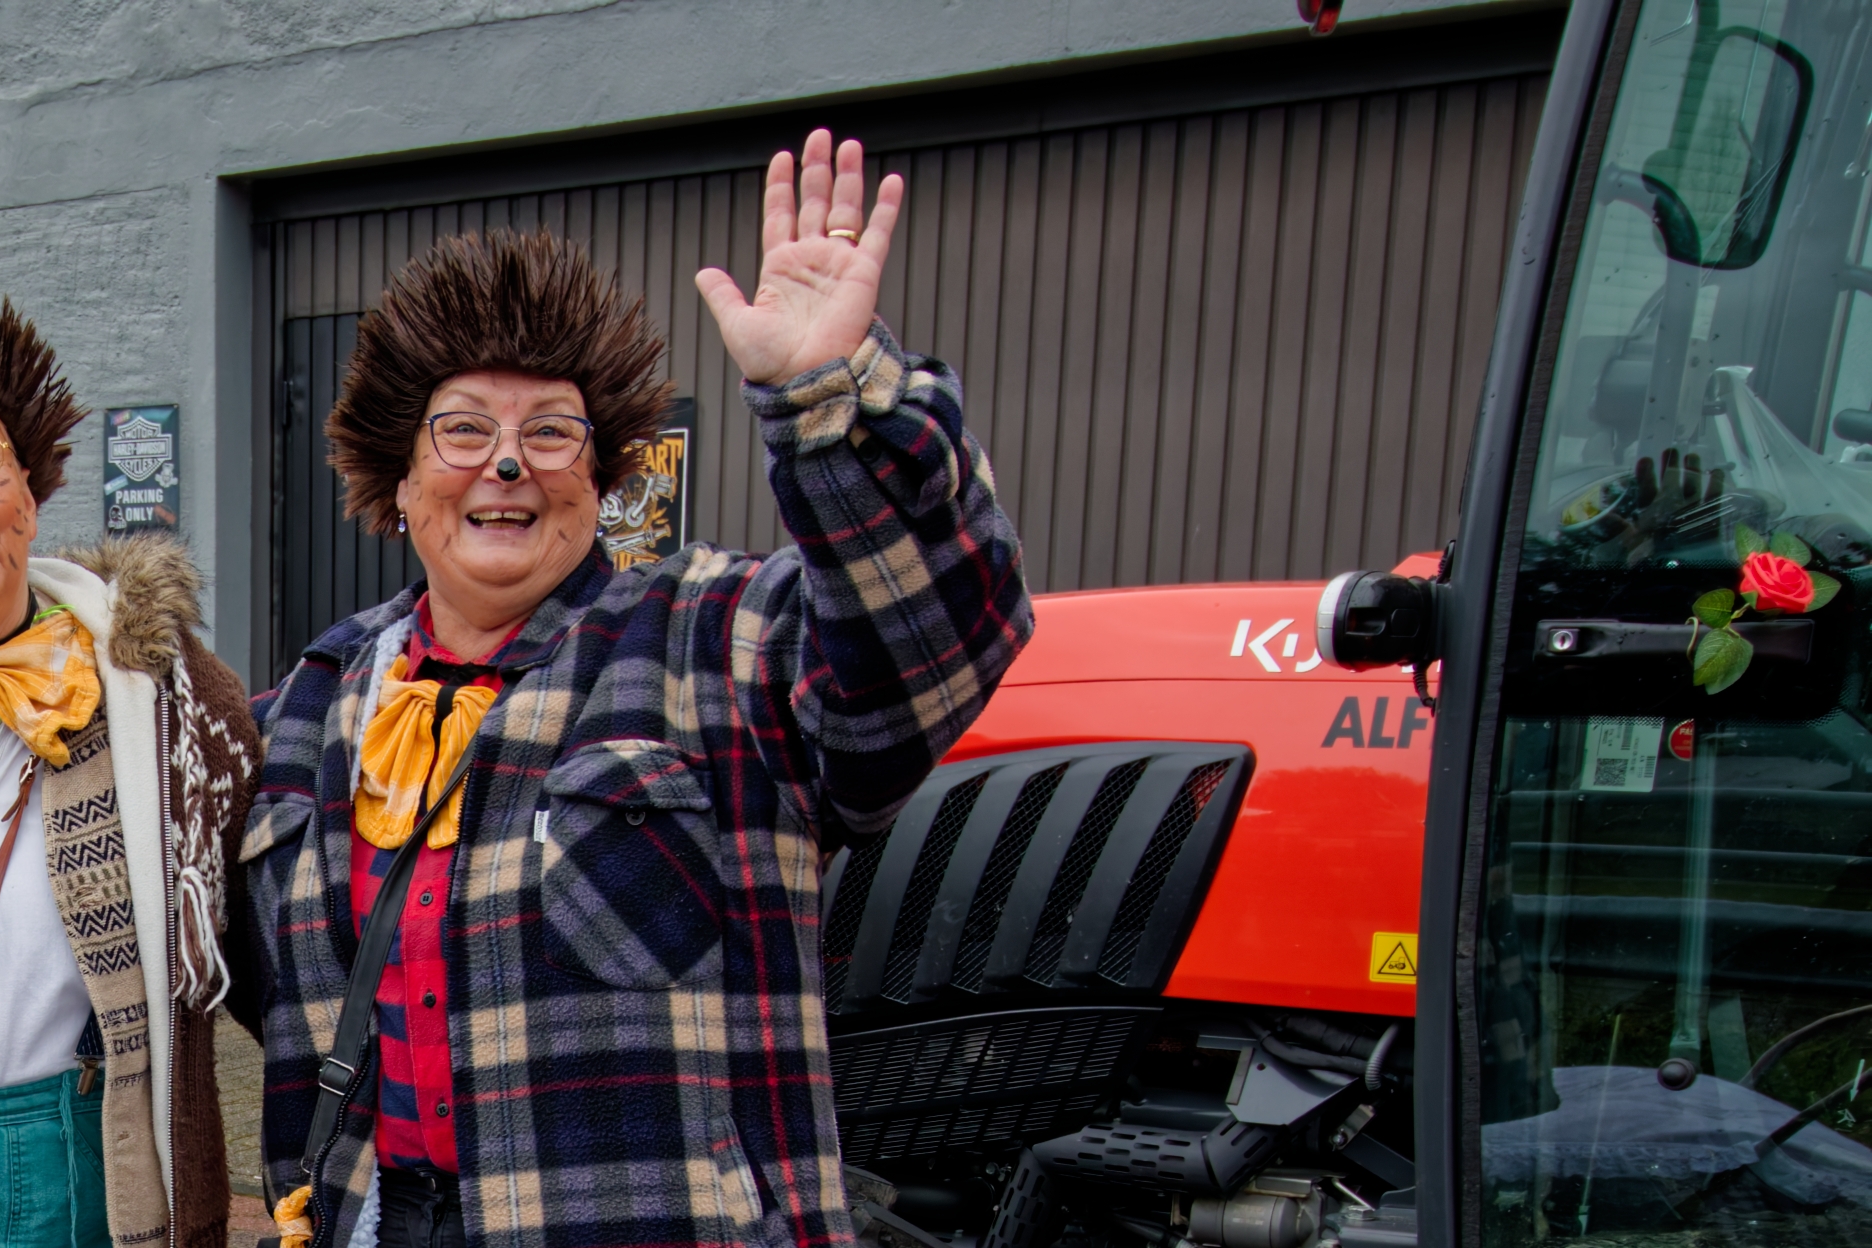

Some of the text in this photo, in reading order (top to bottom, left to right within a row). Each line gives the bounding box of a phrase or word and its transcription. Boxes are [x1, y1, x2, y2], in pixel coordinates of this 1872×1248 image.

[124, 425, 155, 439] MOTOR
[115, 489, 164, 504] PARKING
[125, 507, 155, 522] ONLY
